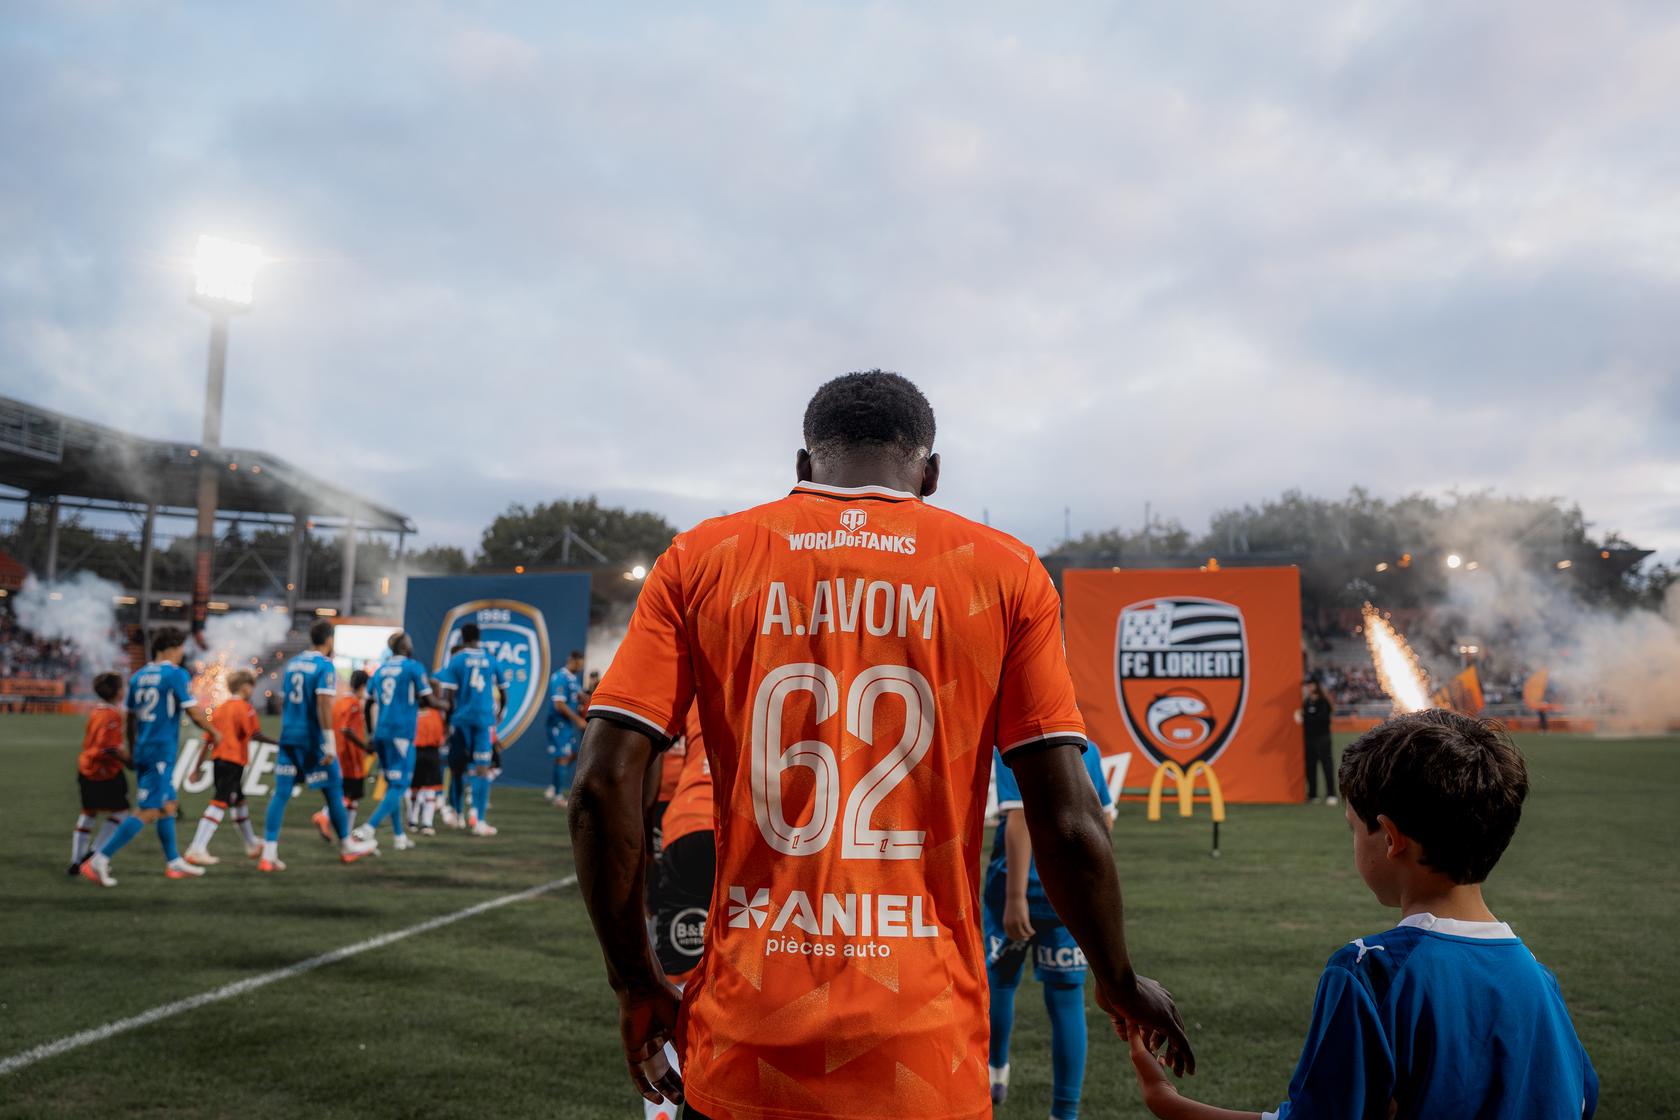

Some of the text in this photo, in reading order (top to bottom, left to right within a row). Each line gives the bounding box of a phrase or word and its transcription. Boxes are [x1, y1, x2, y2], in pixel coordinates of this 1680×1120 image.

[789, 530, 916, 555] WORLD OF TANKS
[761, 577, 936, 640] A.AVOM
[477, 640, 529, 665] TAC
[1121, 651, 1242, 677] FC LORIENT
[289, 672, 304, 704] 3
[469, 666, 486, 692] 4
[751, 662, 935, 860] 62
[770, 890, 939, 937] ANIEL
[765, 936, 891, 958] pièces auto
